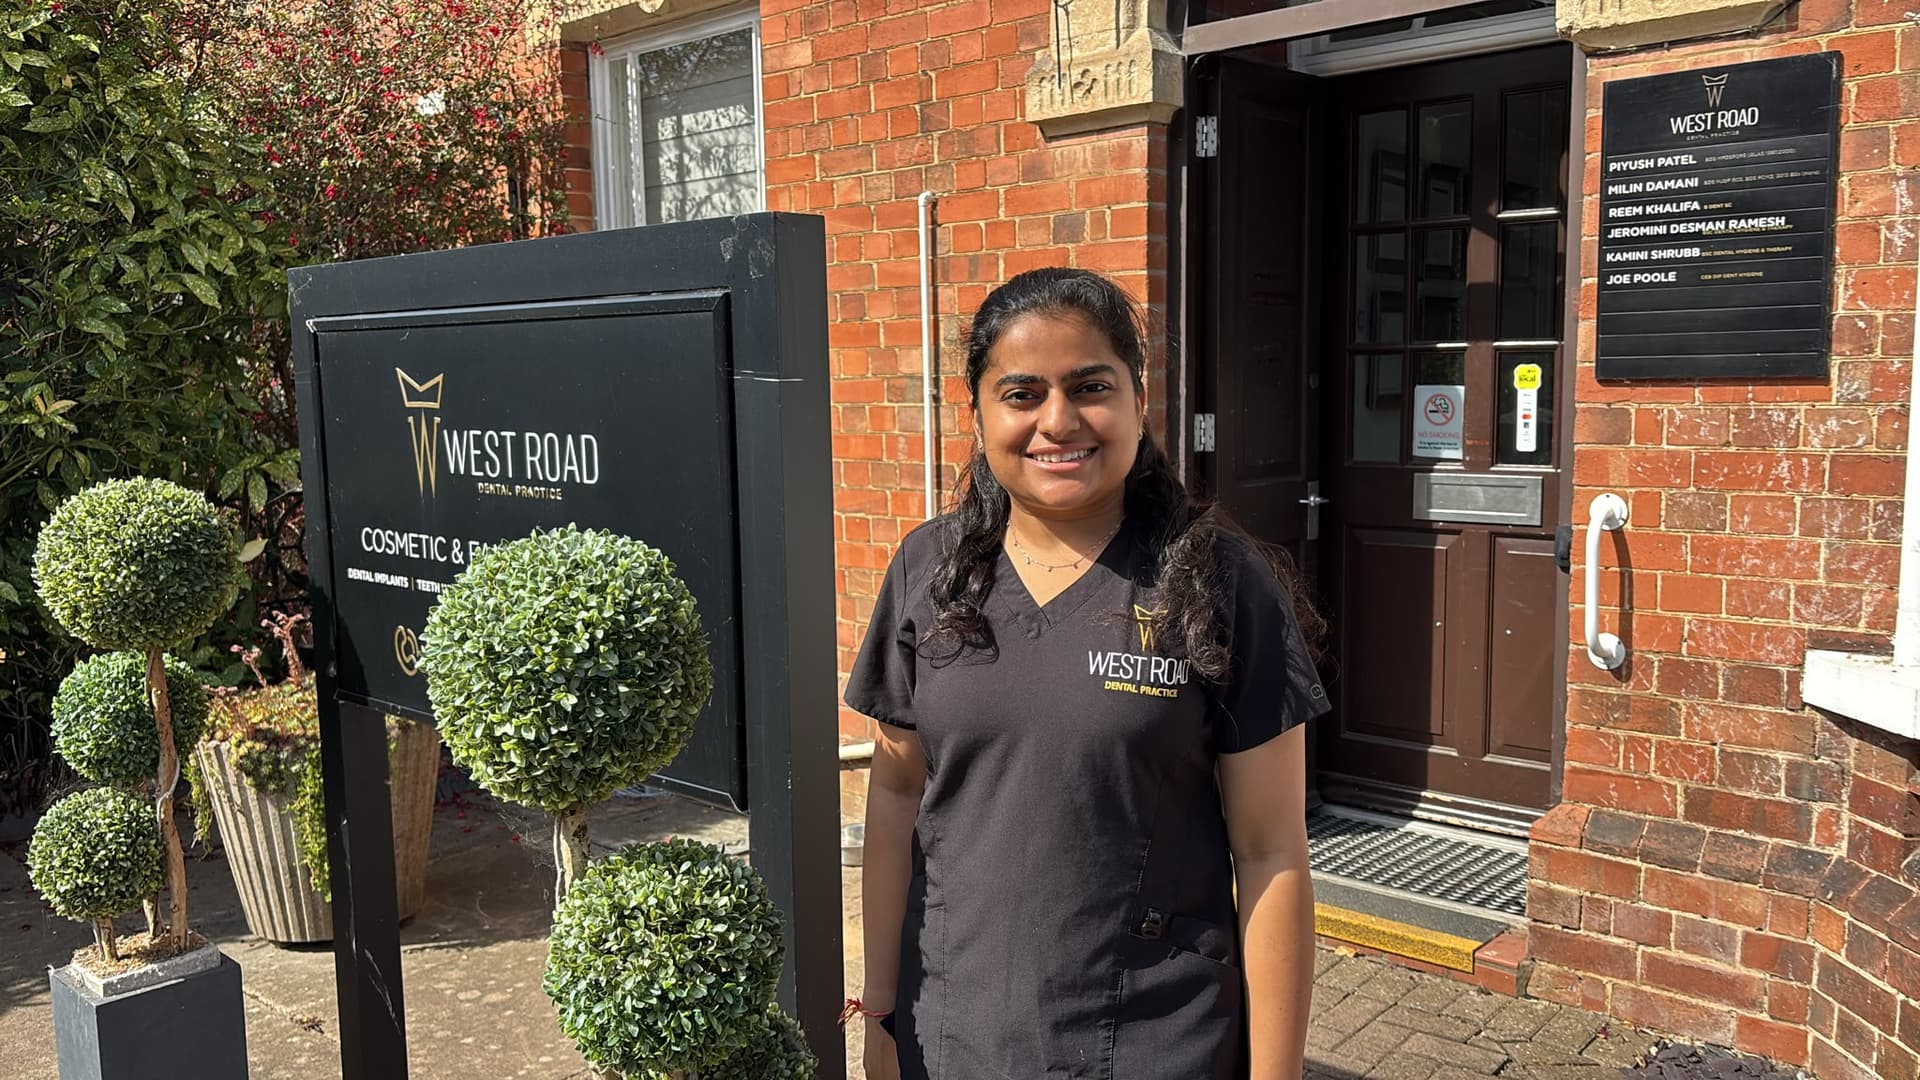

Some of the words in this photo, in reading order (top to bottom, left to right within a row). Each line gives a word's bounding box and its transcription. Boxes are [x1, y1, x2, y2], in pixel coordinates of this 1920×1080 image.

[1670, 112, 1715, 134] WEST
[1717, 107, 1759, 129] ROAD
[1608, 158, 1655, 172] PIYUSH
[1657, 154, 1697, 167] PATEL
[1608, 182, 1643, 195] MILIN
[1645, 177, 1699, 192] DAMANI
[1608, 205, 1643, 218] REEM
[1645, 201, 1700, 215] KHALIFA
[1607, 224, 1668, 239] JEROMINI
[1669, 219, 1726, 234] DESMAN
[1728, 215, 1786, 230] RAMESH
[1606, 251, 1649, 263] KAMINI
[1650, 247, 1701, 261] SHRUBB
[1606, 273, 1632, 285] JOE
[1633, 271, 1678, 284] POOLE
[443, 429, 516, 479] WEST
[525, 432, 599, 485] ROAD
[477, 482, 513, 497] DENTAL
[515, 485, 562, 500] PRACTICE
[360, 526, 448, 563] COSMETIC
[451, 538, 465, 565] &
[347, 567, 374, 583] DENTAL
[374, 572, 409, 589] IMPLANTS
[416, 579, 441, 594] TEETH
[1088, 650, 1147, 680] WEST
[1150, 656, 1191, 685] ROAD
[1104, 681, 1138, 693] DENTAL
[1140, 685, 1178, 697] PRACTICE
